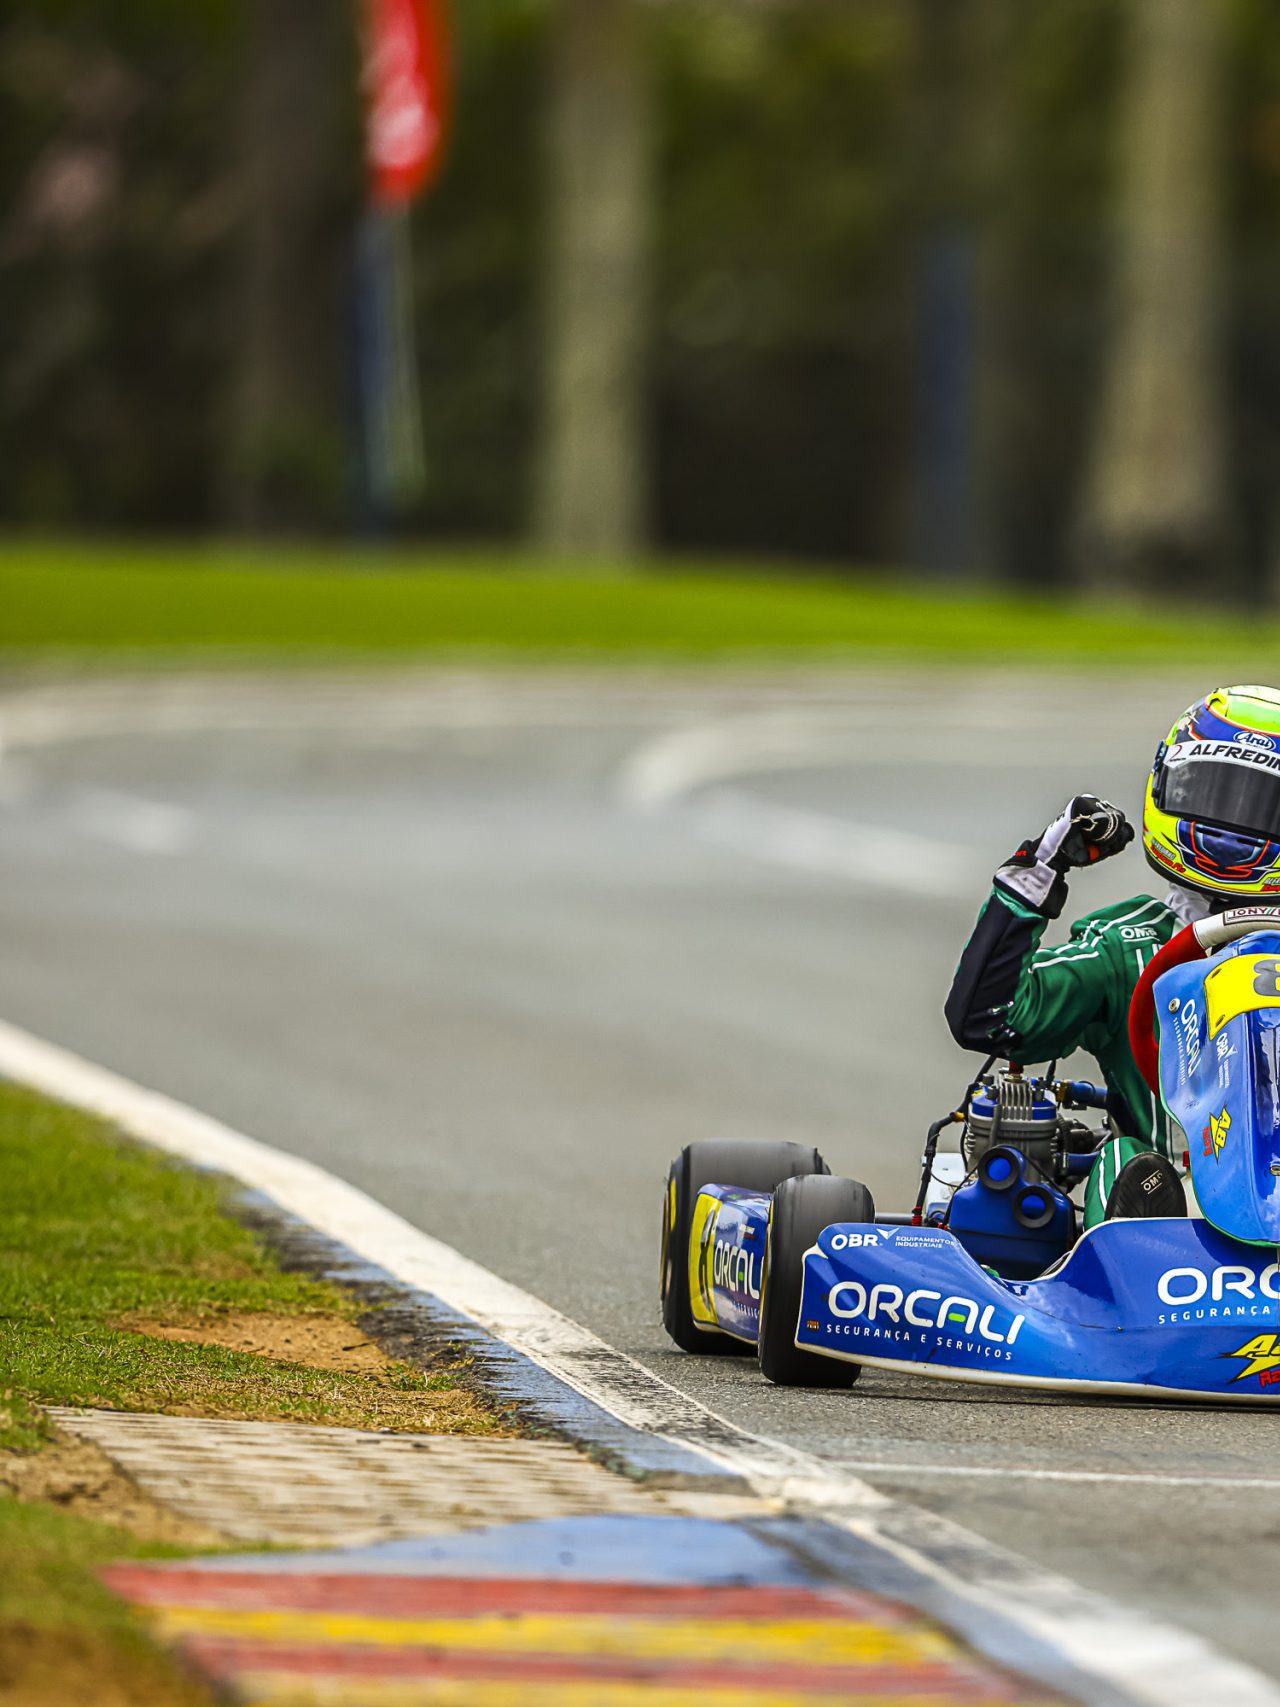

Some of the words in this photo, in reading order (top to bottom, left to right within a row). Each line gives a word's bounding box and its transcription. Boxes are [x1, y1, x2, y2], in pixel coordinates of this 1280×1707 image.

[1237, 732, 1270, 747] Arai
[1181, 999, 1201, 1078] ORCALI
[831, 1233, 879, 1250] OBR
[895, 1241, 943, 1249] INDUSTRIAIS
[828, 1281, 1025, 1345] ORCALI
[1158, 1306, 1271, 1325] SEGURANÇA
[826, 1323, 911, 1343] SEGURANÇA
[920, 1334, 927, 1344] E
[936, 1336, 1013, 1361] SERVIÇOS
